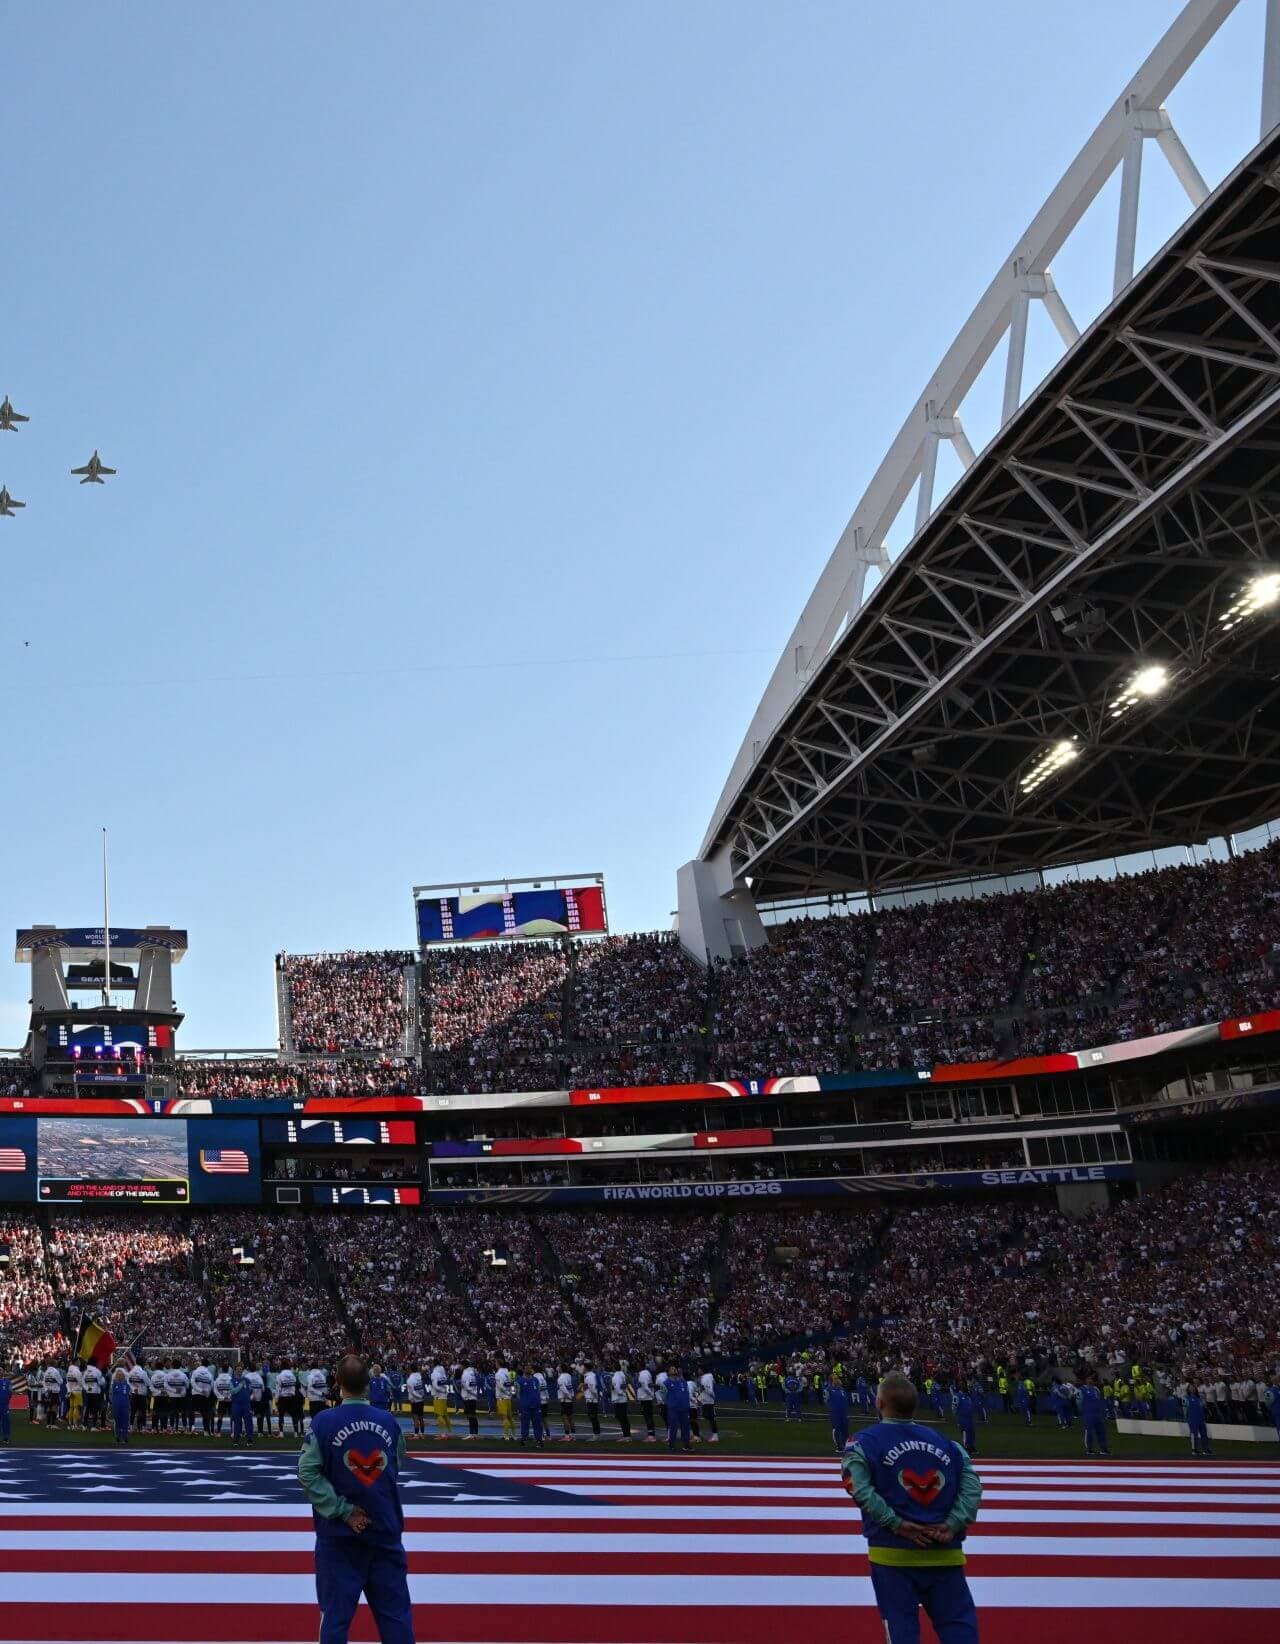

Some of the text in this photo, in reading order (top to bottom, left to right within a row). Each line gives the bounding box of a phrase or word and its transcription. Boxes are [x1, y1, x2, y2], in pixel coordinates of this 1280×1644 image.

[981, 1166, 1106, 1185] SEATTLE
[603, 1182, 782, 1200] FIFA WORLD CUP 2026
[332, 1420, 393, 1447] VOLUNTEER
[883, 1440, 952, 1466] VOLUNTEER
